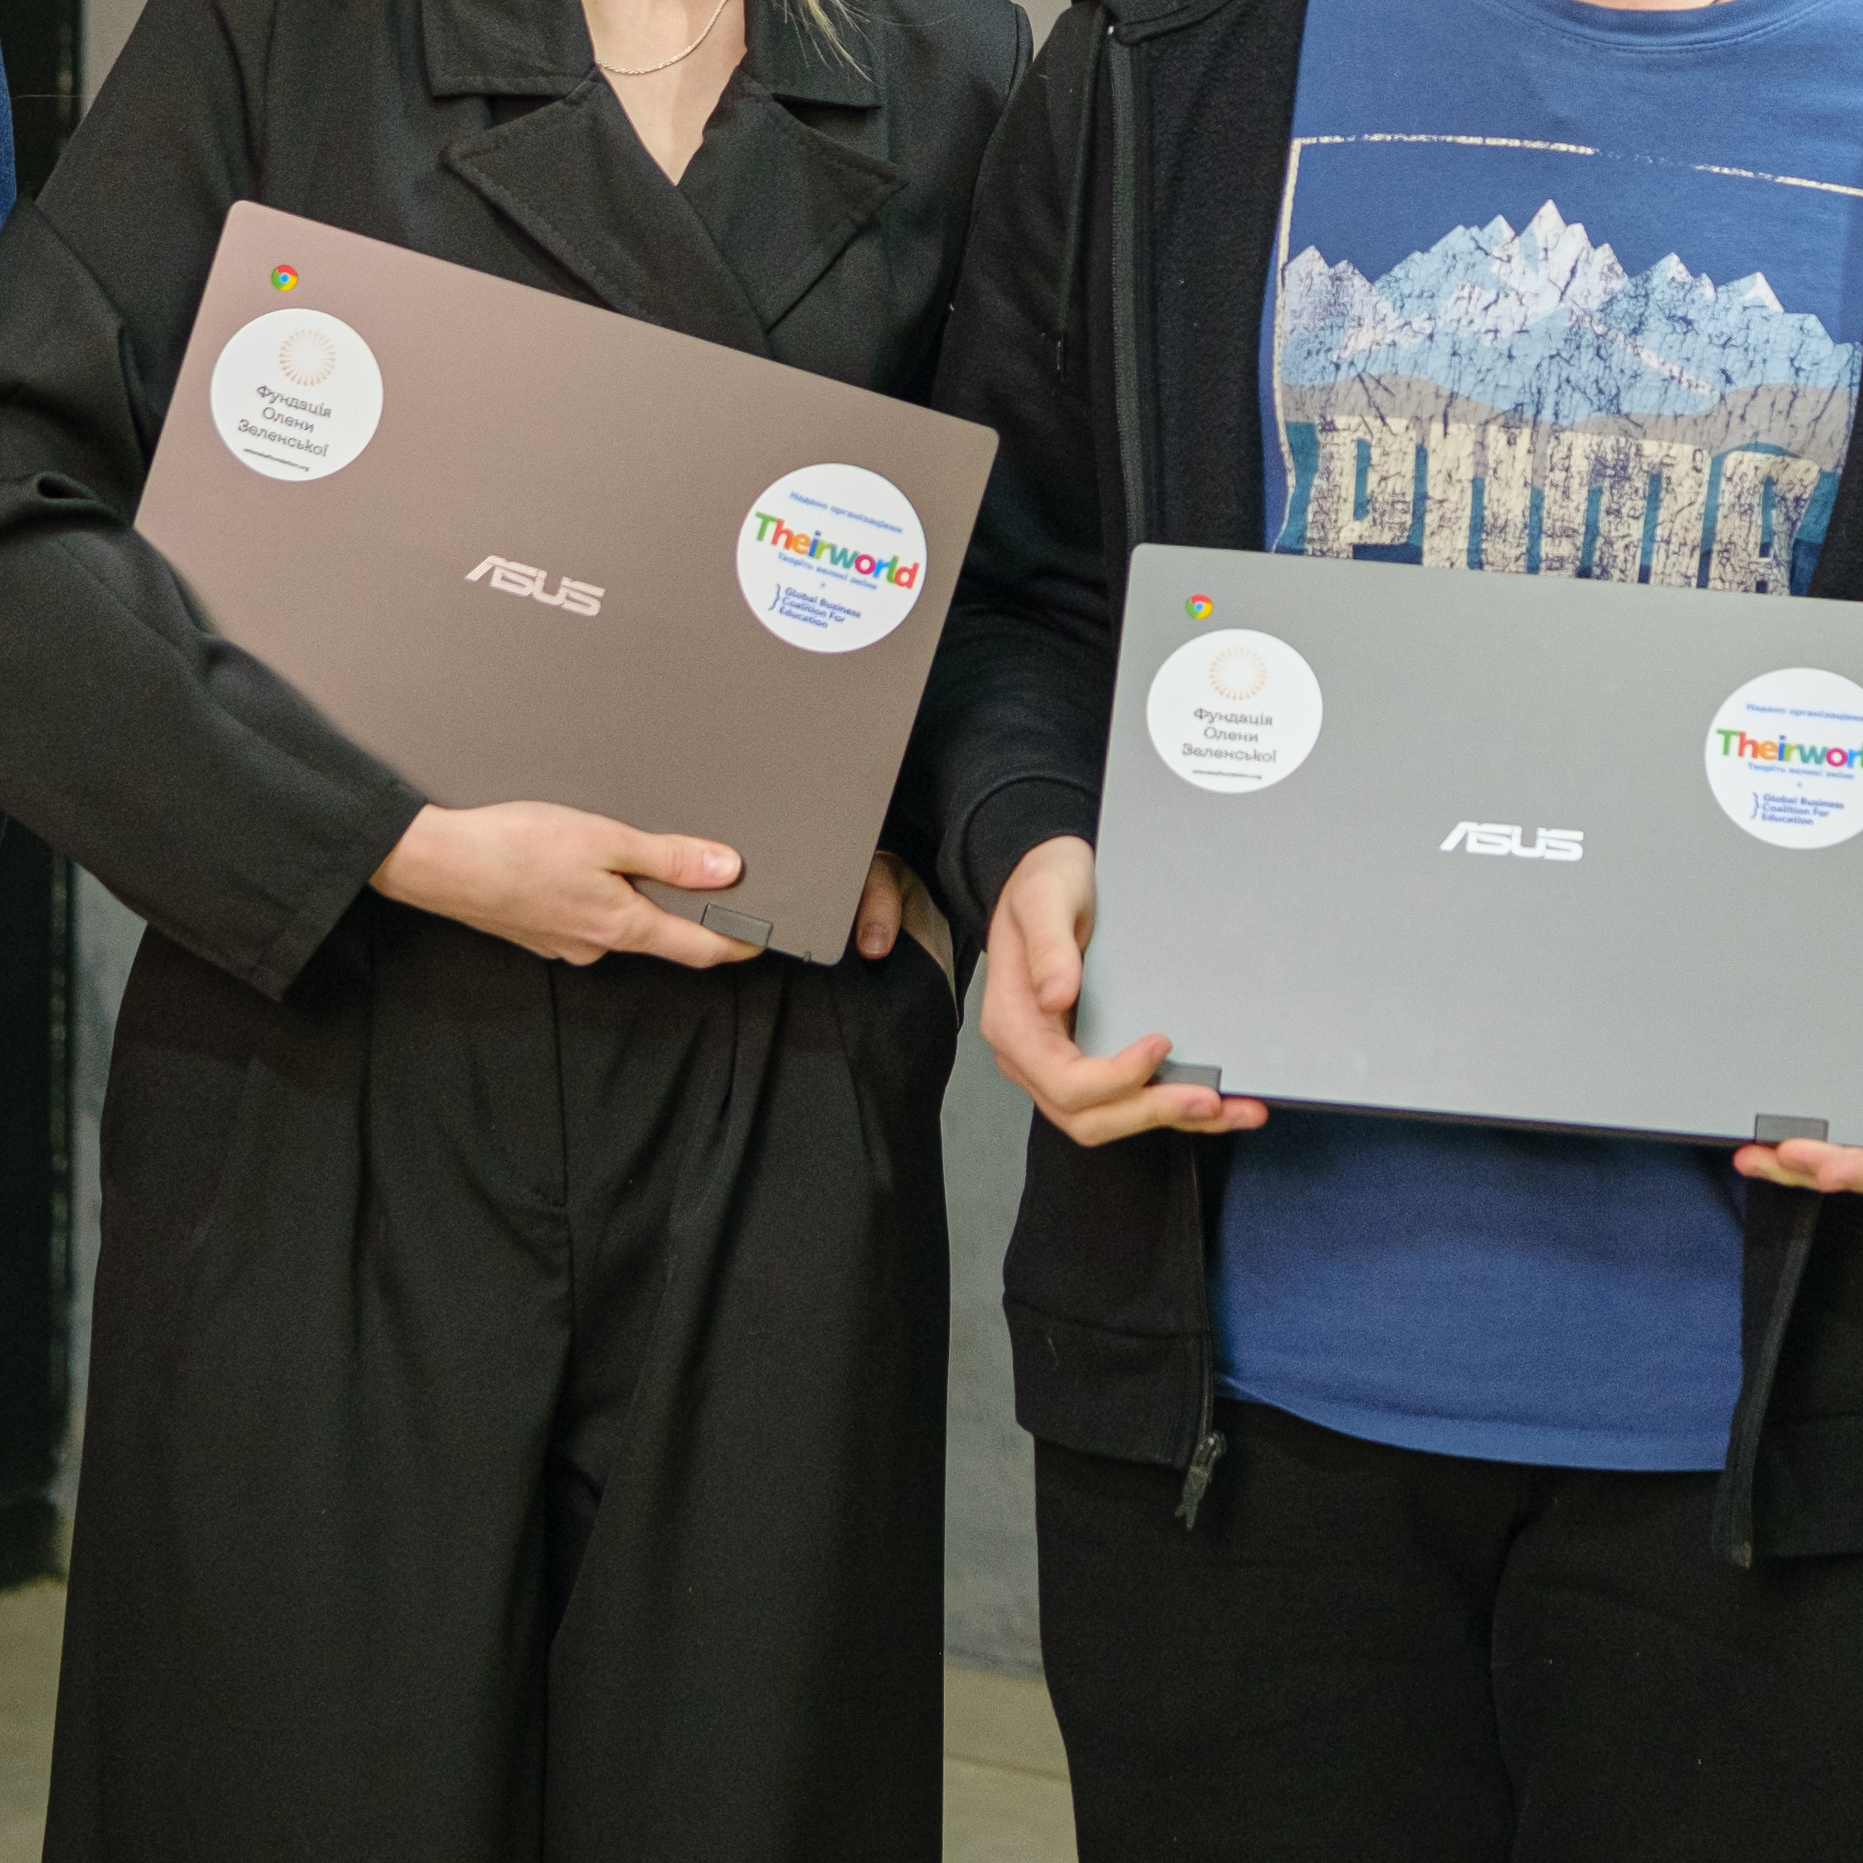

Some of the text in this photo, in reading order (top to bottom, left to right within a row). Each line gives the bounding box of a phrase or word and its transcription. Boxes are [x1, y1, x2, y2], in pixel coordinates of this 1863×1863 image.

[257, 384, 332, 419] Фундація
[262, 406, 315, 434] Олени
[238, 419, 330, 458] Зеленської
[755, 511, 920, 590] Theirworld
[464, 555, 606, 617] ASUS
[1193, 706, 1273, 727] Фундація
[1203, 725, 1259, 744] Олени
[1439, 820, 1585, 862] ASUS
